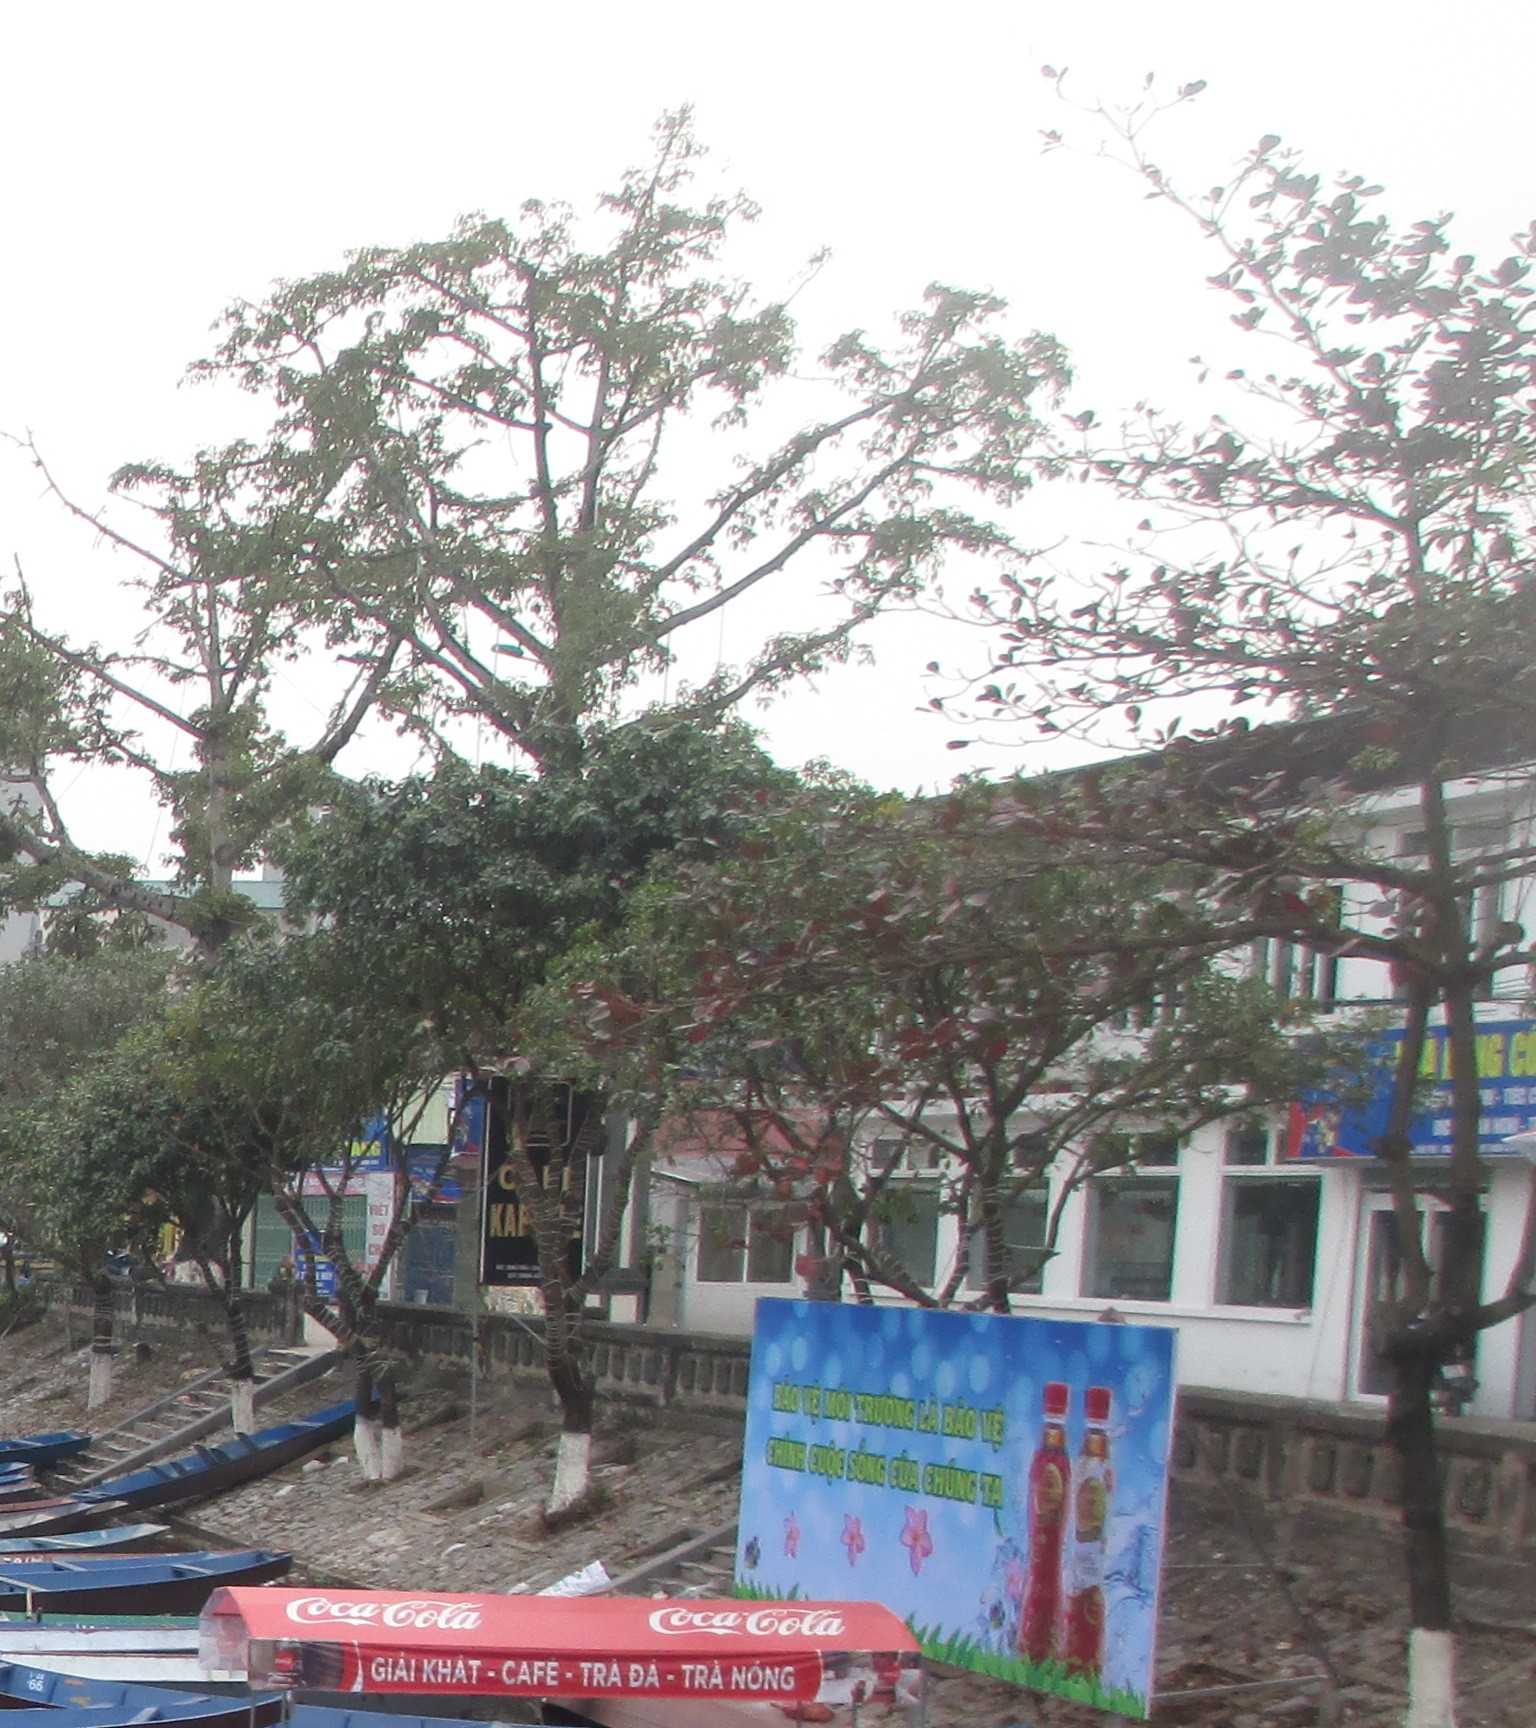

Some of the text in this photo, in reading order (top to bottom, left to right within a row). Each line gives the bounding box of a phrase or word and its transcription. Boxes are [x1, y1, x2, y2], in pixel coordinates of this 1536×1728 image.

[285, 1596, 484, 1630] Coca-Cola
[648, 1606, 848, 1637] Coca-Cola
[422, 1653, 483, 1685] KHÁT
[579, 1658, 623, 1688] TRÀ
[628, 1658, 660, 1690] ĐÁ
[681, 1659, 724, 1690] TRÀ
[730, 1660, 796, 1692] NÓNG
